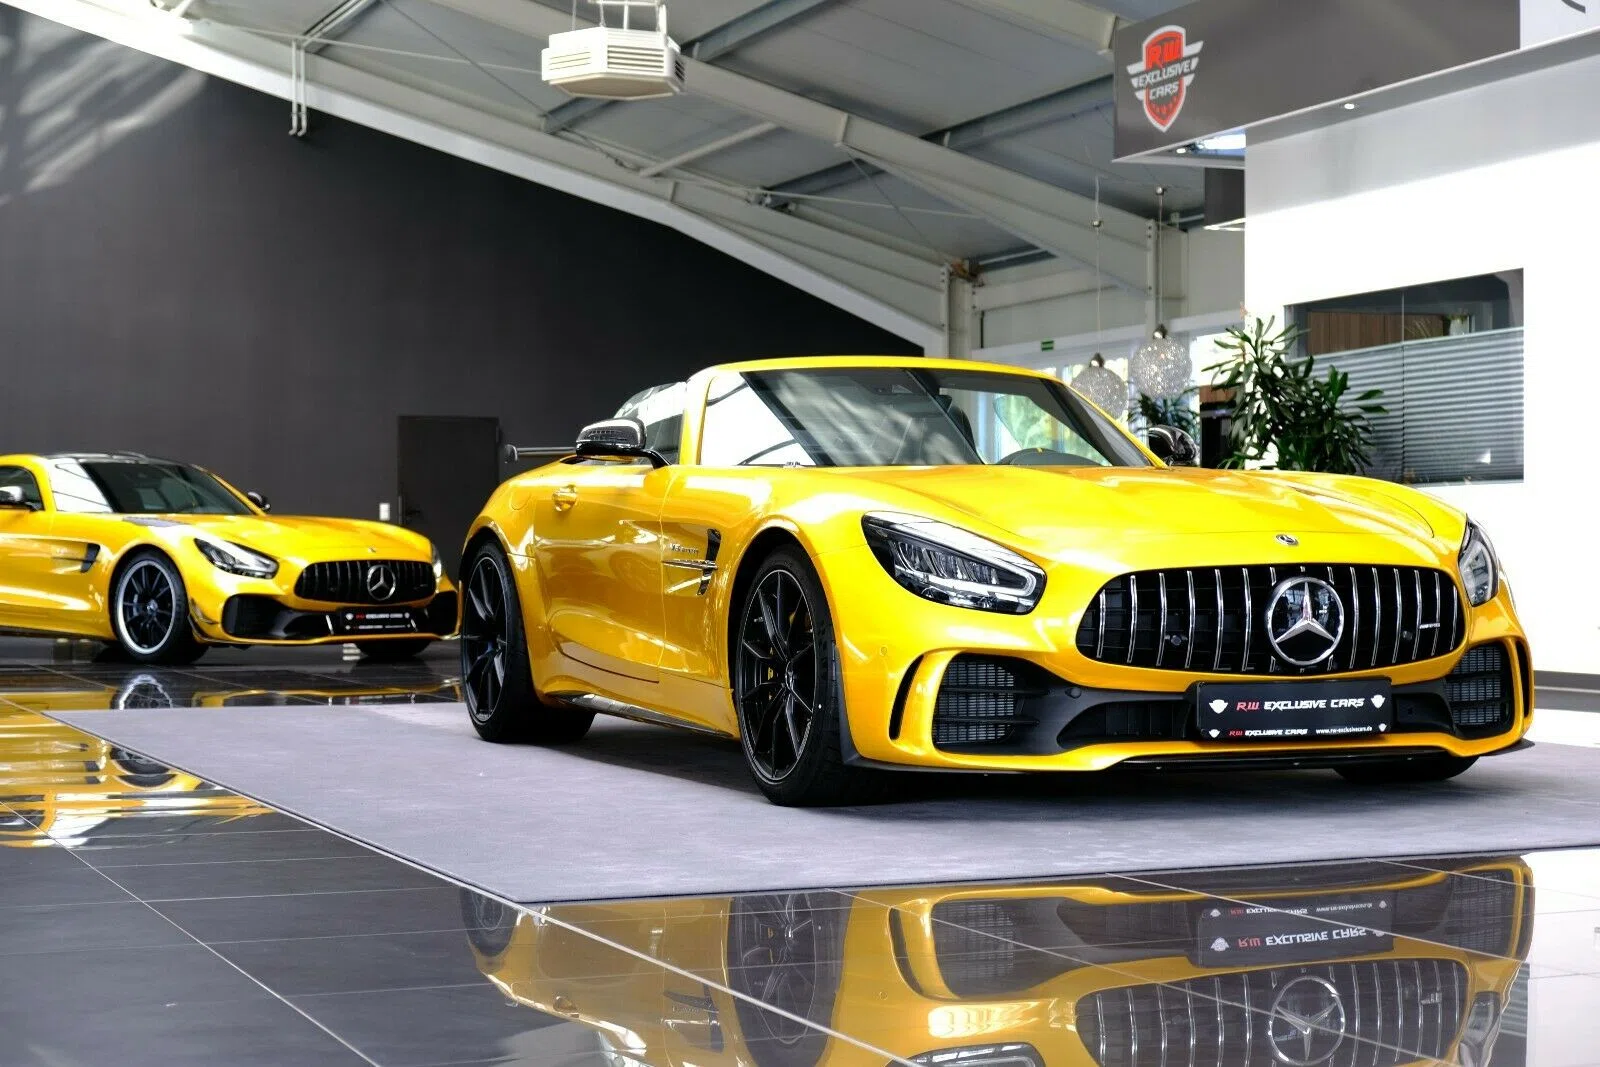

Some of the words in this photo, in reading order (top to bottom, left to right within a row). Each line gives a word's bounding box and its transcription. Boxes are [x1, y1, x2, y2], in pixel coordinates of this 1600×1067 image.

[1138, 59, 1191, 87] EXCLUSIVE
[1149, 81, 1180, 100] CARS
[1263, 700, 1328, 712] EXCLUSIVE
[1330, 698, 1366, 709] CARS
[1245, 729, 1284, 737] EXCLUSIVE
